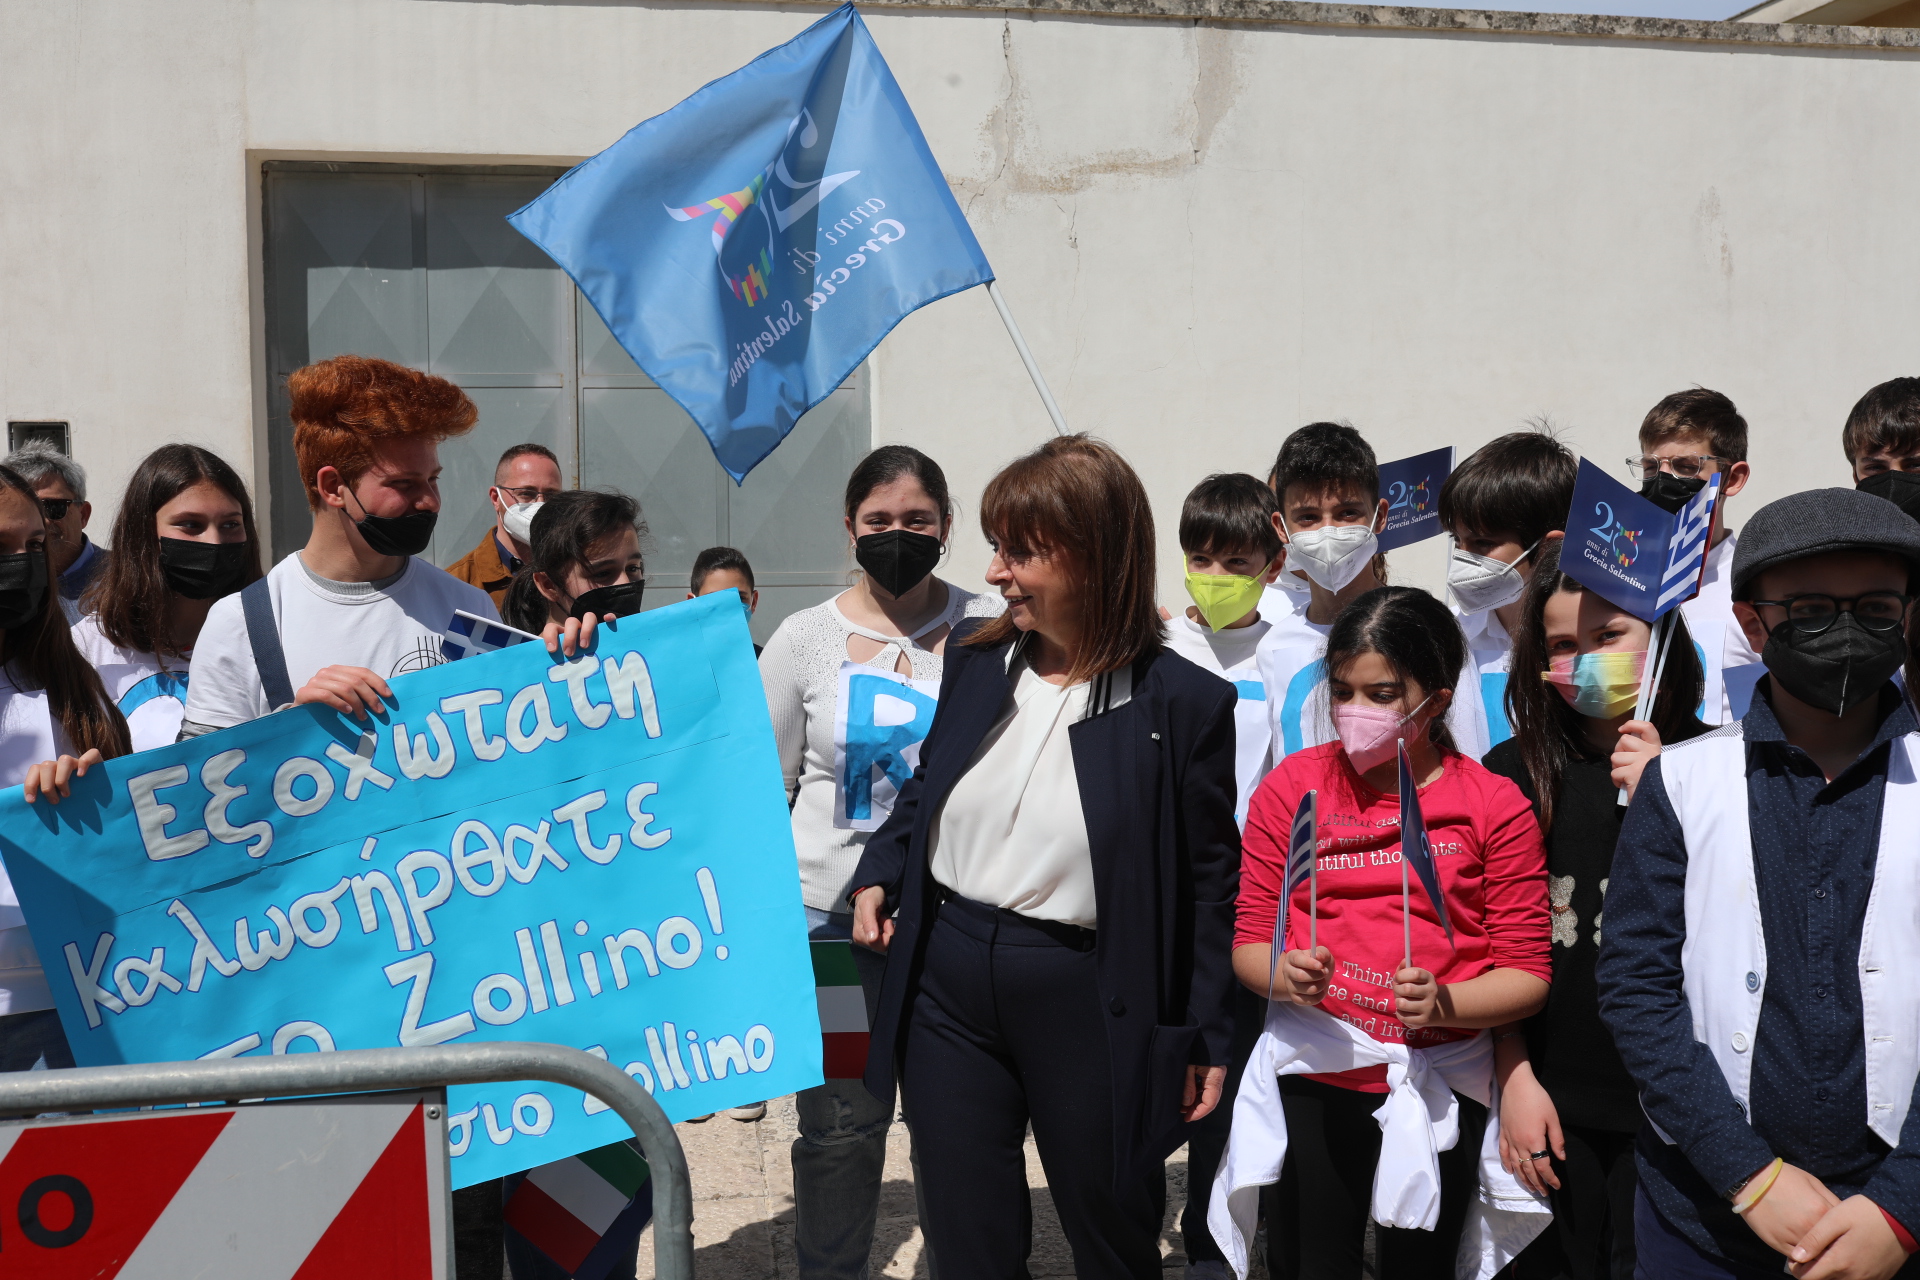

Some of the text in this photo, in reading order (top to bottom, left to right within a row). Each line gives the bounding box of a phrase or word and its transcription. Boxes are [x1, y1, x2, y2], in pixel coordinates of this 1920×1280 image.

[1586, 539, 1609, 557] anni di
[1608, 564, 1647, 592] Salentina
[127, 650, 663, 862] Εξοχωτατη
[844, 673, 938, 820] R
[63, 782, 673, 1030] Καλωσήρθατε
[384, 867, 730, 1047] Zollino!
[1342, 961, 1394, 989] Think
[1327, 984, 1389, 1012] ce and
[1341, 1013, 1376, 1034] and
[1380, 1021, 1416, 1040] live
